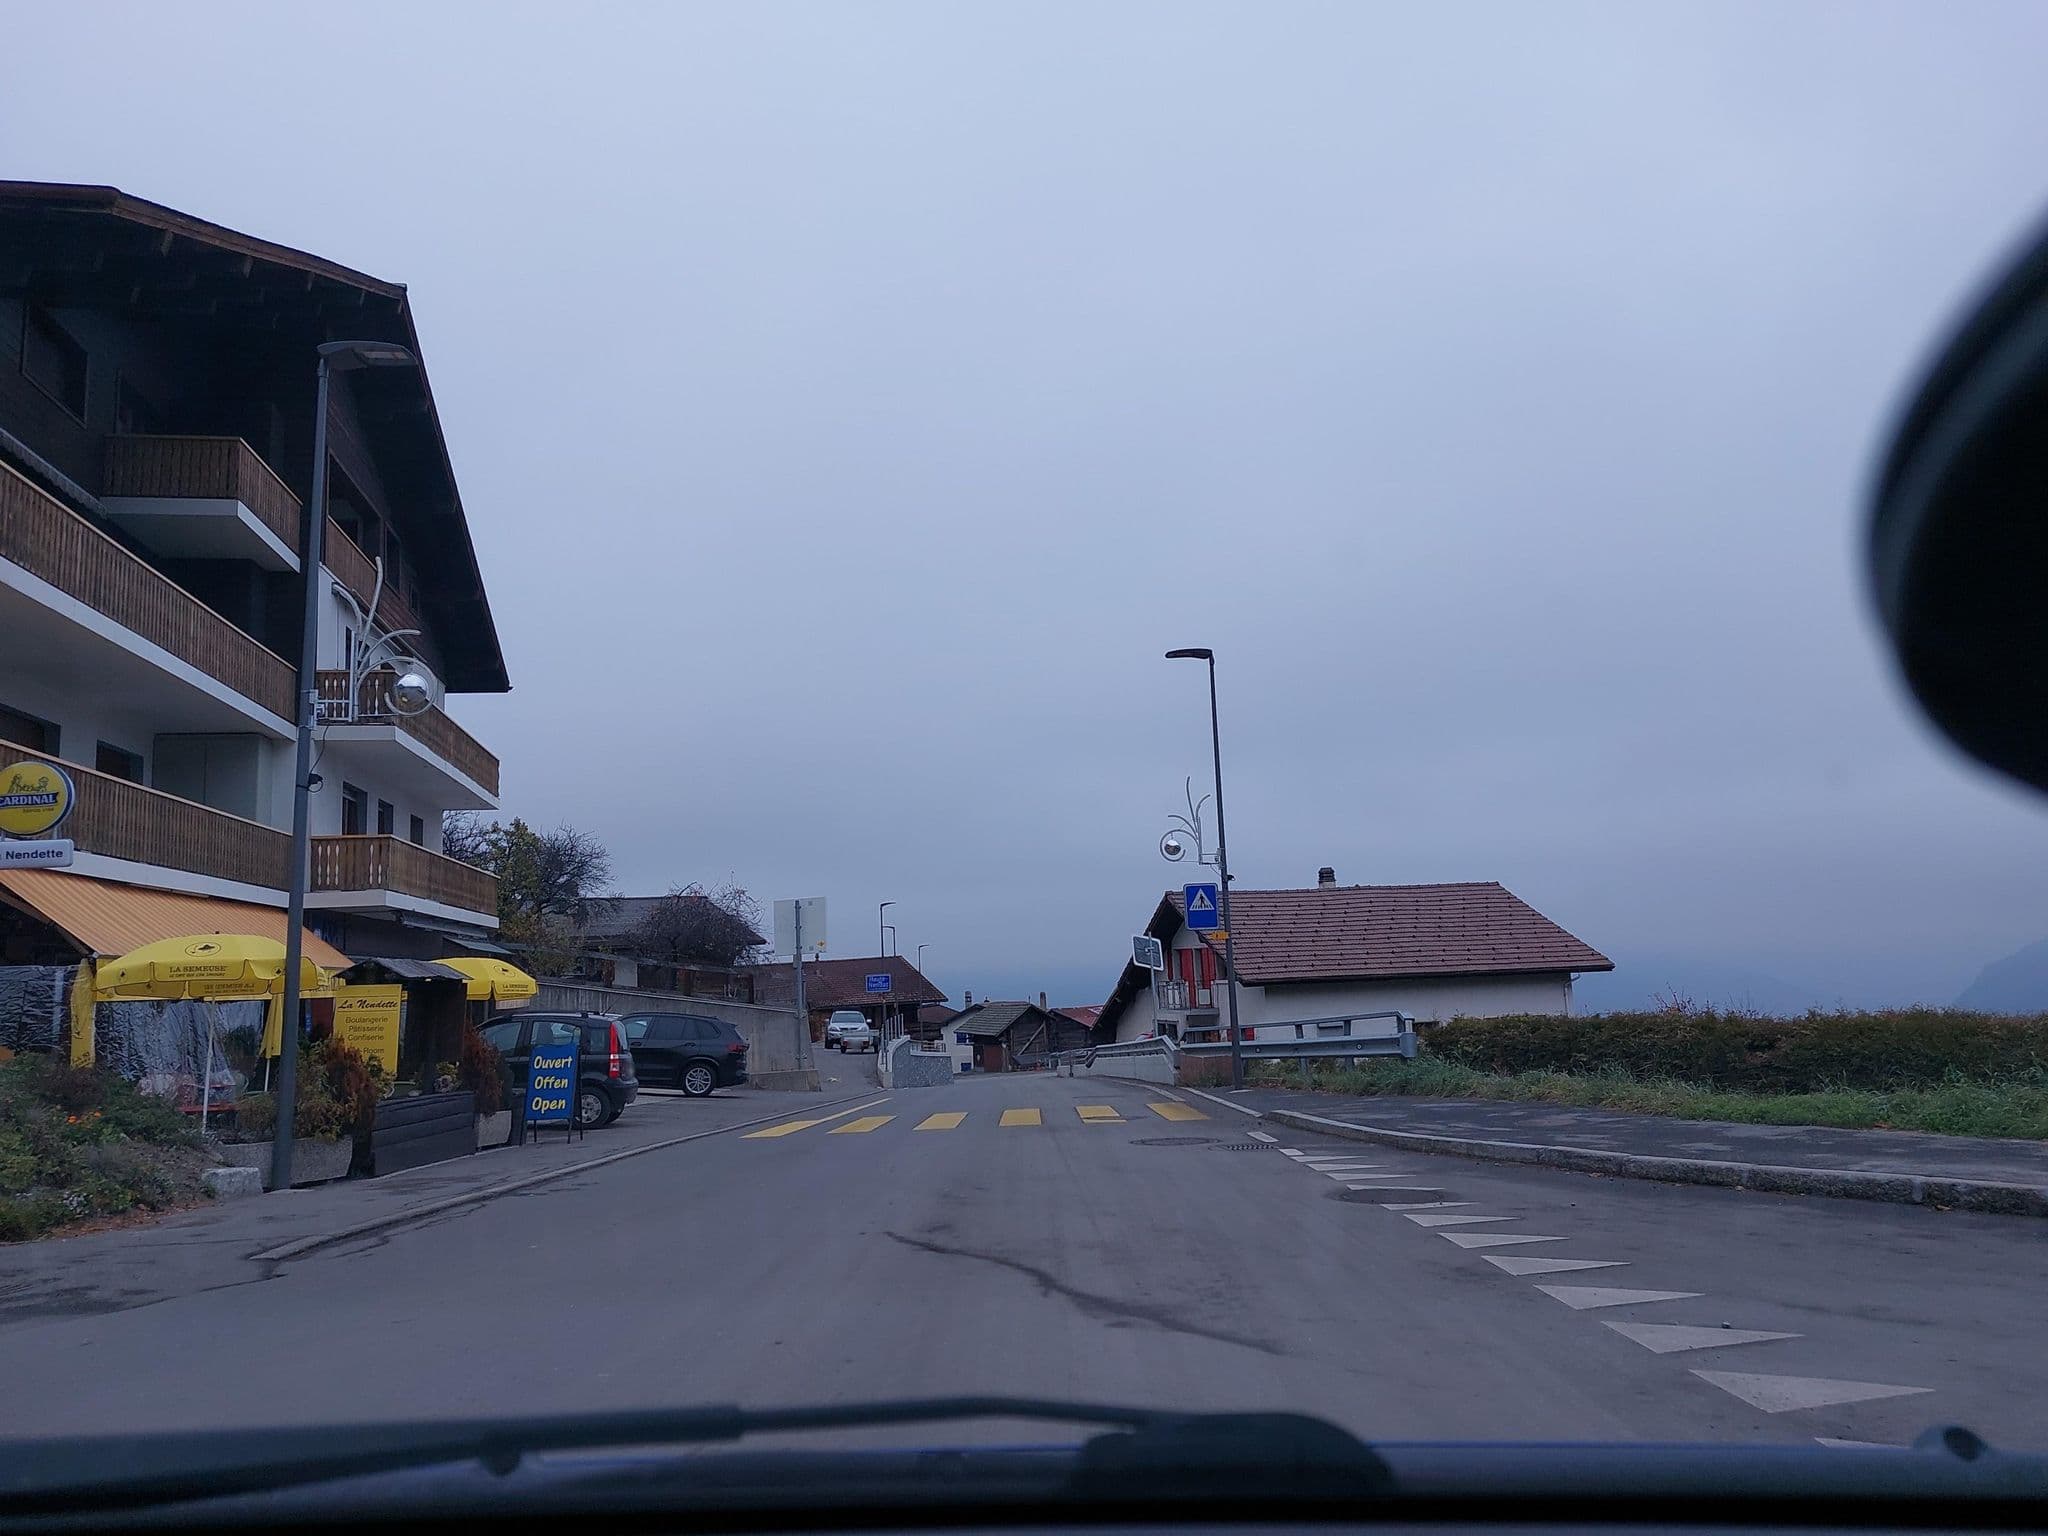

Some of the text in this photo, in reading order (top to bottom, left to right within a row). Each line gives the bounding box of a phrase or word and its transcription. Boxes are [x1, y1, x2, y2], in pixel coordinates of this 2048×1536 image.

[0, 794, 56, 806] CARDINAL
[5, 850, 63, 860] Nendette
[183, 965, 226, 973] SEMEUSE
[338, 999, 398, 1009] La Nendette
[345, 1016, 389, 1024] Boulangerie
[534, 1055, 573, 1069] Ouvert
[534, 1076, 568, 1090] Offen
[532, 1096, 566, 1114] Open
